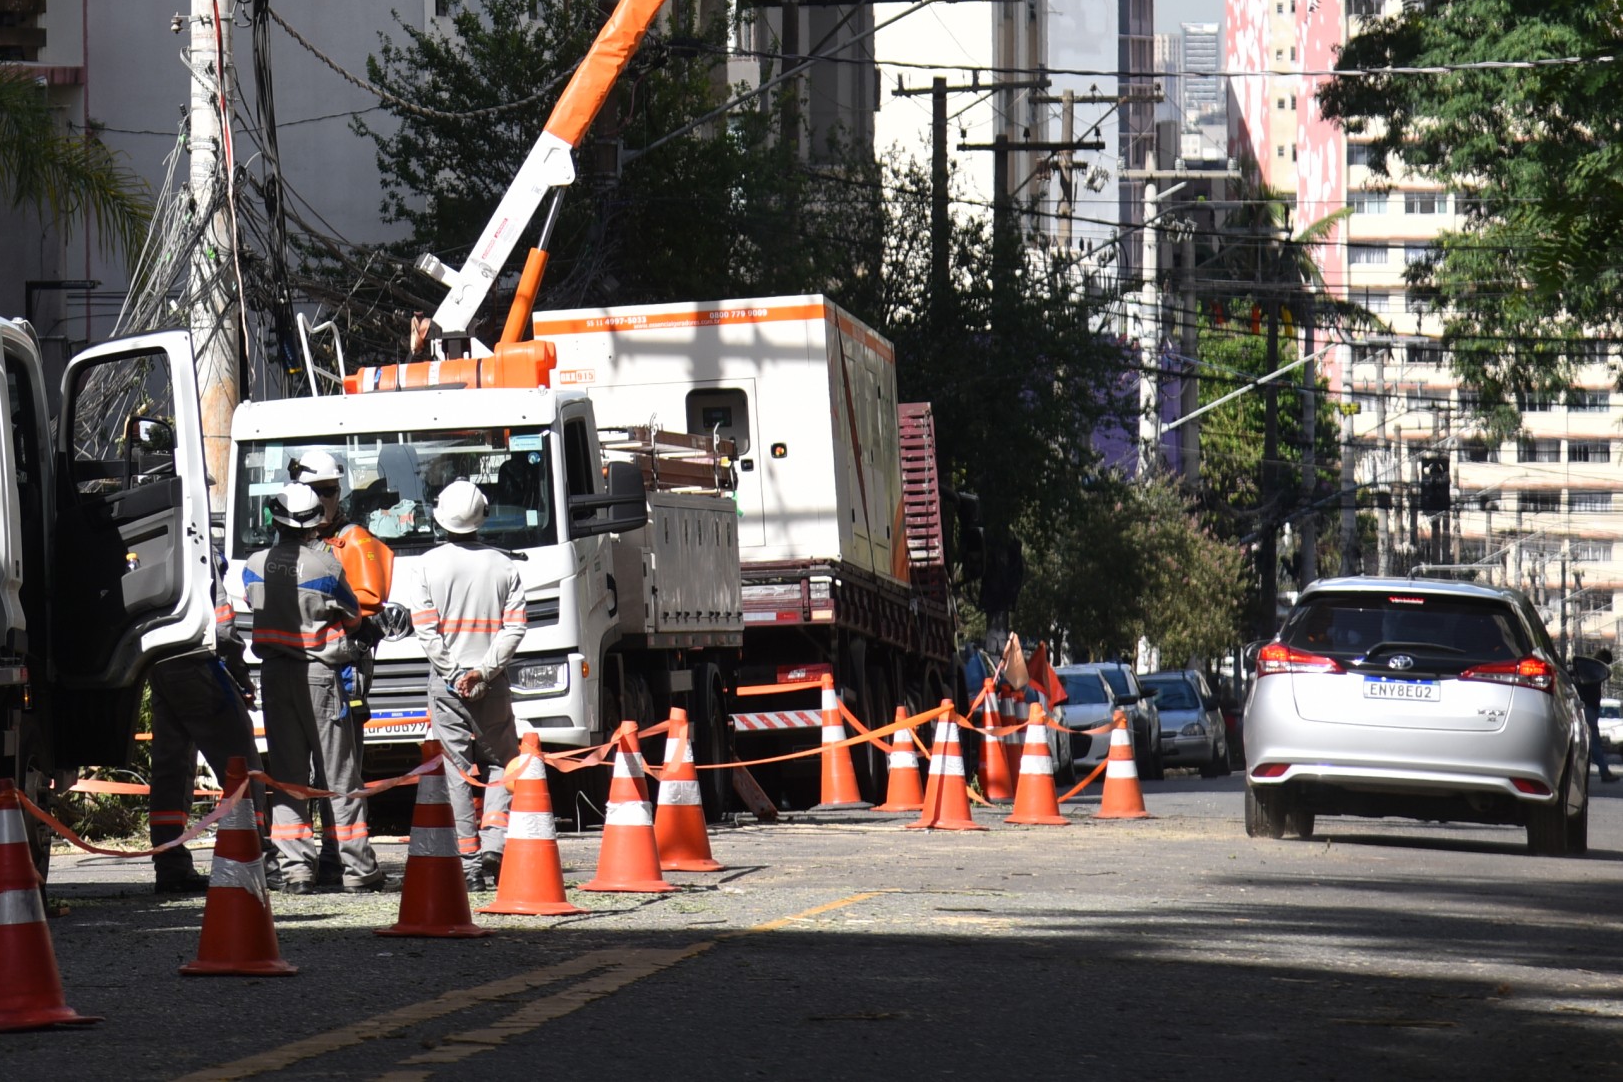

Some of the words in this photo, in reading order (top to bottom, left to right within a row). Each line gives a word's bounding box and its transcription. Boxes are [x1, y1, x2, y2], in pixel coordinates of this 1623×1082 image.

[709, 311, 729, 319] 0800
[731, 310, 746, 318] 779
[266, 561, 304, 579] enel
[1370, 683, 1432, 699] ENY8E02
